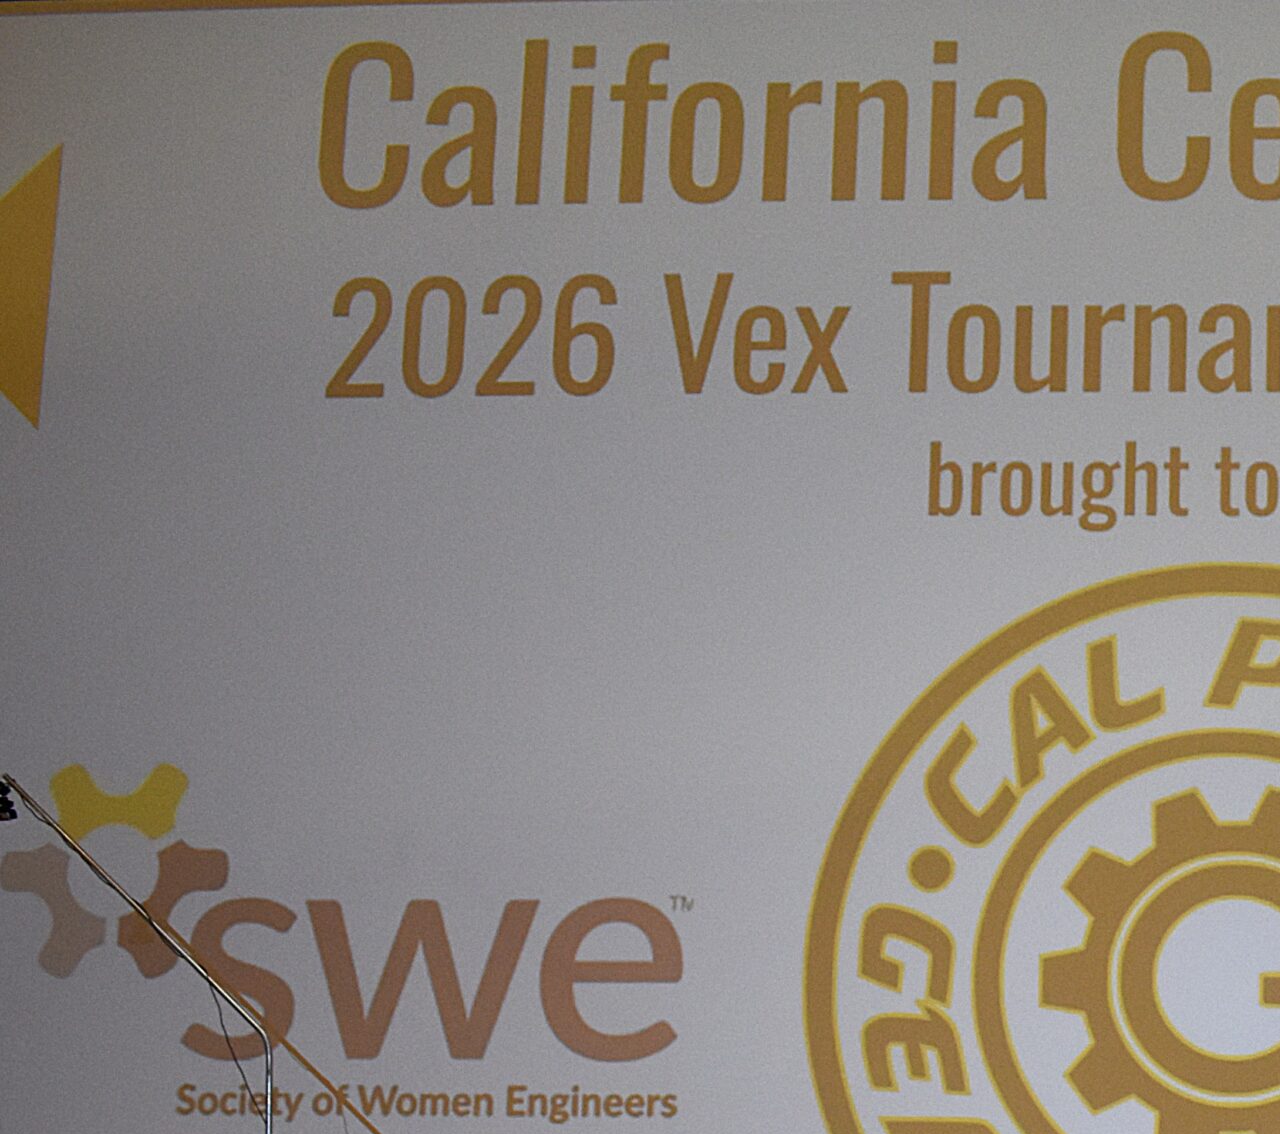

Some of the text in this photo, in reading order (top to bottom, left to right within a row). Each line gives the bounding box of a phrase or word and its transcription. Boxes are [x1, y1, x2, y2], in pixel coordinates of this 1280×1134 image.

[318, 38, 1048, 209] California
[325, 273, 618, 399] 2026
[664, 273, 851, 395] Vex
[927, 441, 1188, 532] brought
[1215, 446, 1280, 518] to
[925, 634, 1167, 847] CAL
[180, 897, 684, 1063] swe
[175, 1083, 678, 1124] Society of Women Engineers
